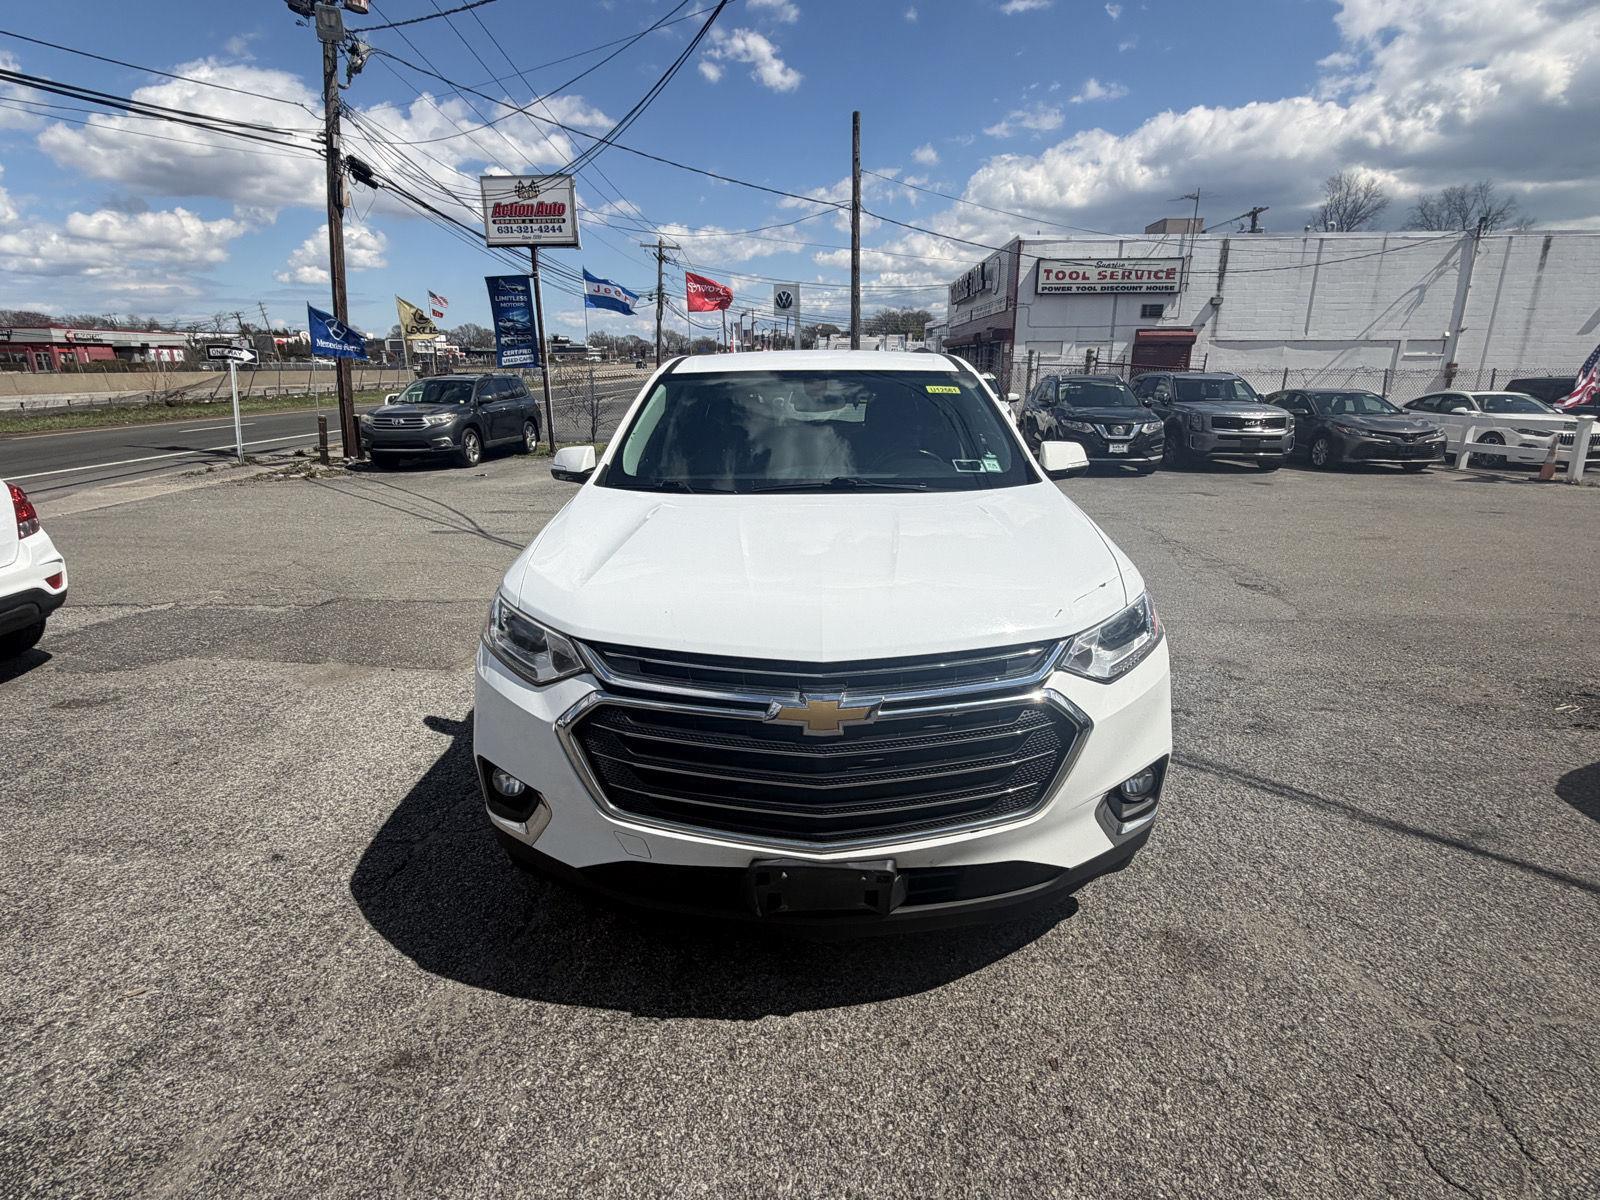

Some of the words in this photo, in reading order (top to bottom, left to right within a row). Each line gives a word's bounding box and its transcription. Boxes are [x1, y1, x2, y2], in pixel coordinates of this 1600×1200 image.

[491, 202, 534, 218] Action
[534, 201, 566, 217] Auto
[497, 225, 563, 234] 631-321-4244
[1043, 269, 1090, 281] TOOL
[1097, 267, 1177, 281] SERVICE
